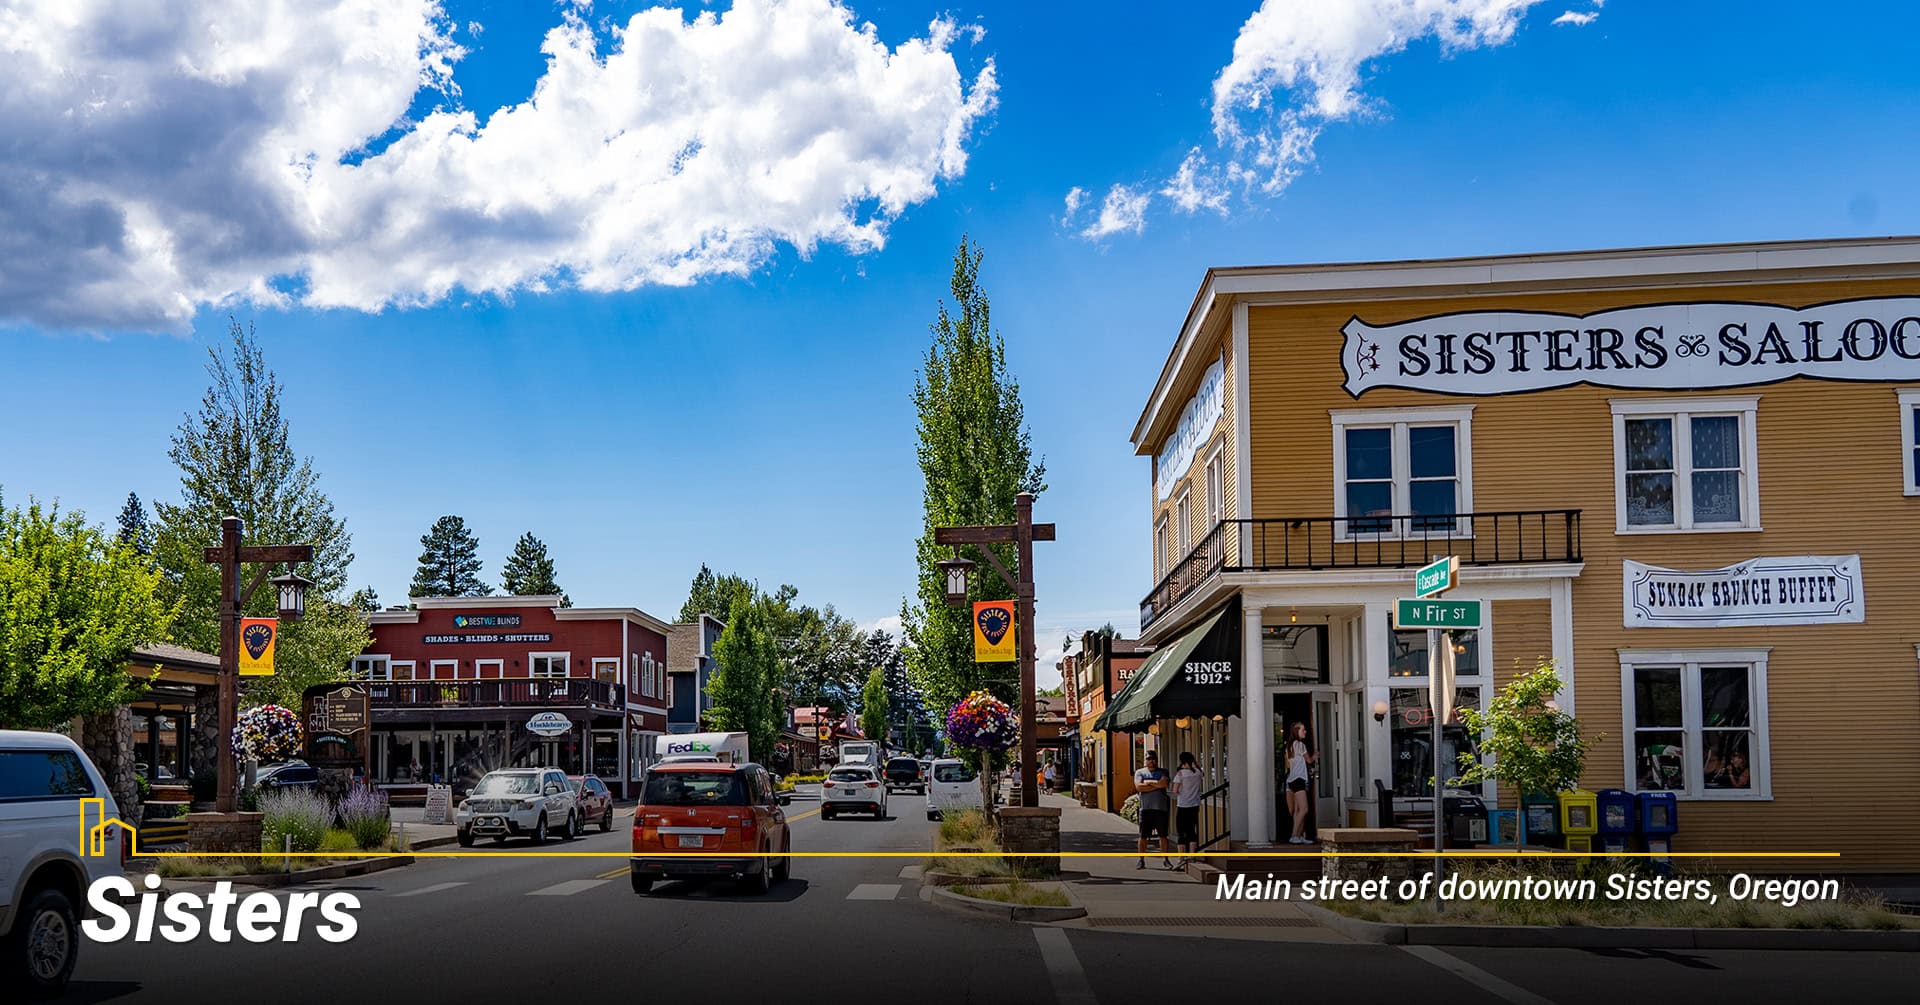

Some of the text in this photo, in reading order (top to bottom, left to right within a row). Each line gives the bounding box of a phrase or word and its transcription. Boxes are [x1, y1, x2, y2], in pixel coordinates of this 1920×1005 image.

[1399, 317, 1920, 376] SISTERS SALOO
[1422, 570, 1439, 590] Cascade
[1649, 576, 1836, 607] SUNDAY BRUNCH BUFFET
[981, 609, 1007, 621] SISTERS
[1412, 605, 1466, 621] N Fir ST
[497, 616, 520, 625] BLINDS
[246, 625, 269, 637] SISTERS
[425, 635, 459, 643] SHADES
[1185, 661, 1232, 673] SINCE
[1119, 669, 1138, 679] RA
[1193, 673, 1223, 685] 1912
[1405, 707, 1467, 725] OPN
[667, 741, 711, 754] FedEx
